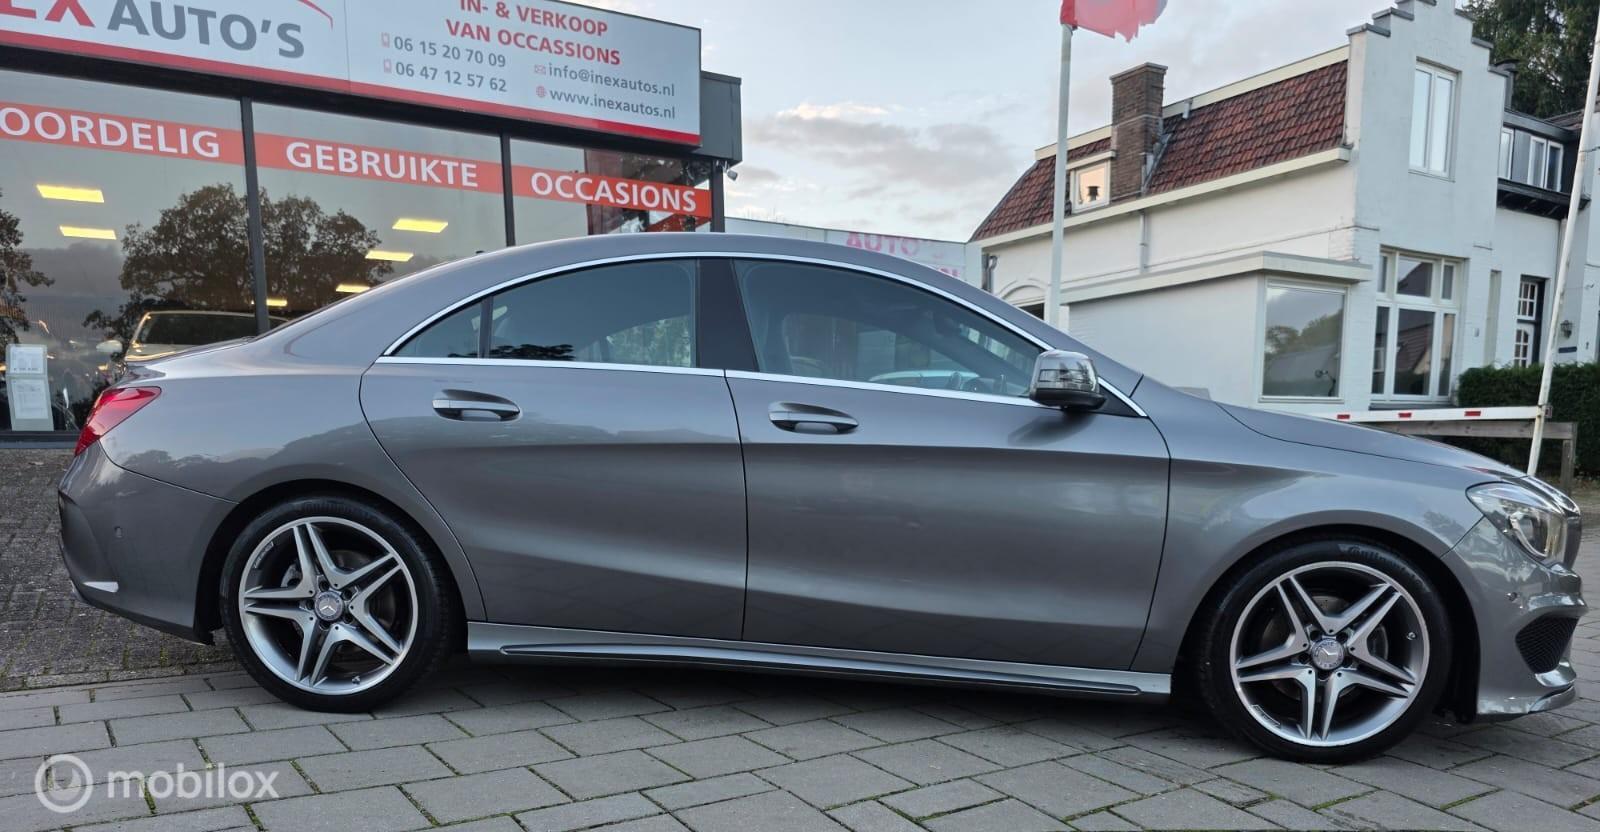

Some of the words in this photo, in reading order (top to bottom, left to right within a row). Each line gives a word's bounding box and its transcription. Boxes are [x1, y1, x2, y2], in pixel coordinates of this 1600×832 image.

[107, 0, 305, 59] AUTO'S
[459, 0, 488, 14] IN-
[496, 3, 510, 19] &
[516, 7, 608, 37] VERKOOP
[394, 37, 413, 52] 06
[419, 41, 438, 56] 15
[442, 45, 461, 60] 20
[466, 48, 484, 63] 70
[488, 52, 506, 67] 09
[446, 19, 490, 42] VAN
[498, 30, 621, 65] OCCASSIONS
[395, 62, 414, 77] 06
[420, 66, 438, 81] 47
[446, 70, 462, 84] 12
[467, 73, 484, 89] 57
[489, 77, 507, 92] 62
[549, 63, 675, 97] info@inexautos.nl
[549, 90, 675, 119] www.inexautos.nl
[0, 107, 220, 158] OORDELIG
[286, 142, 478, 188] GEBRUIKTE
[531, 172, 697, 212] OCCASIONS
